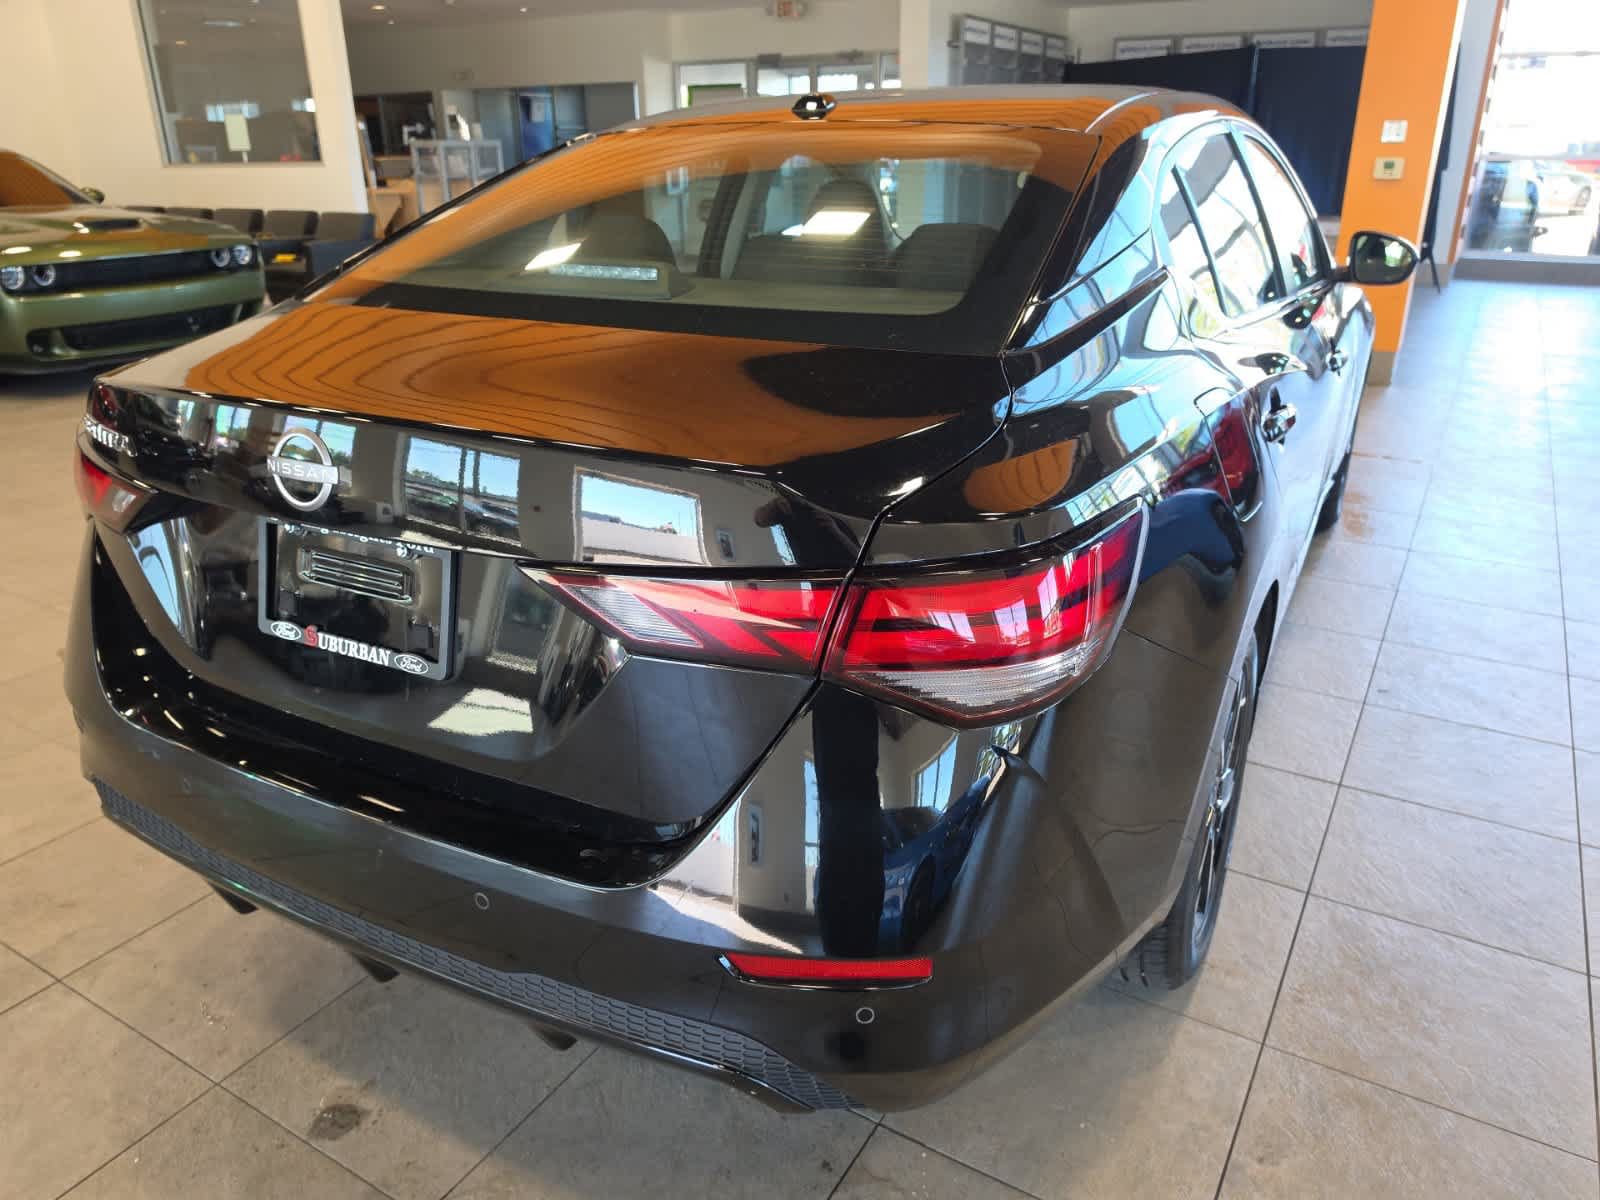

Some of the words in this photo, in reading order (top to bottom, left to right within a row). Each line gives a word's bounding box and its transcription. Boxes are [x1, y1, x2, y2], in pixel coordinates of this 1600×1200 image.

[273, 622, 299, 640] Ford
[304, 624, 391, 667] SUBURBAN
[397, 654, 427, 674] Ford
